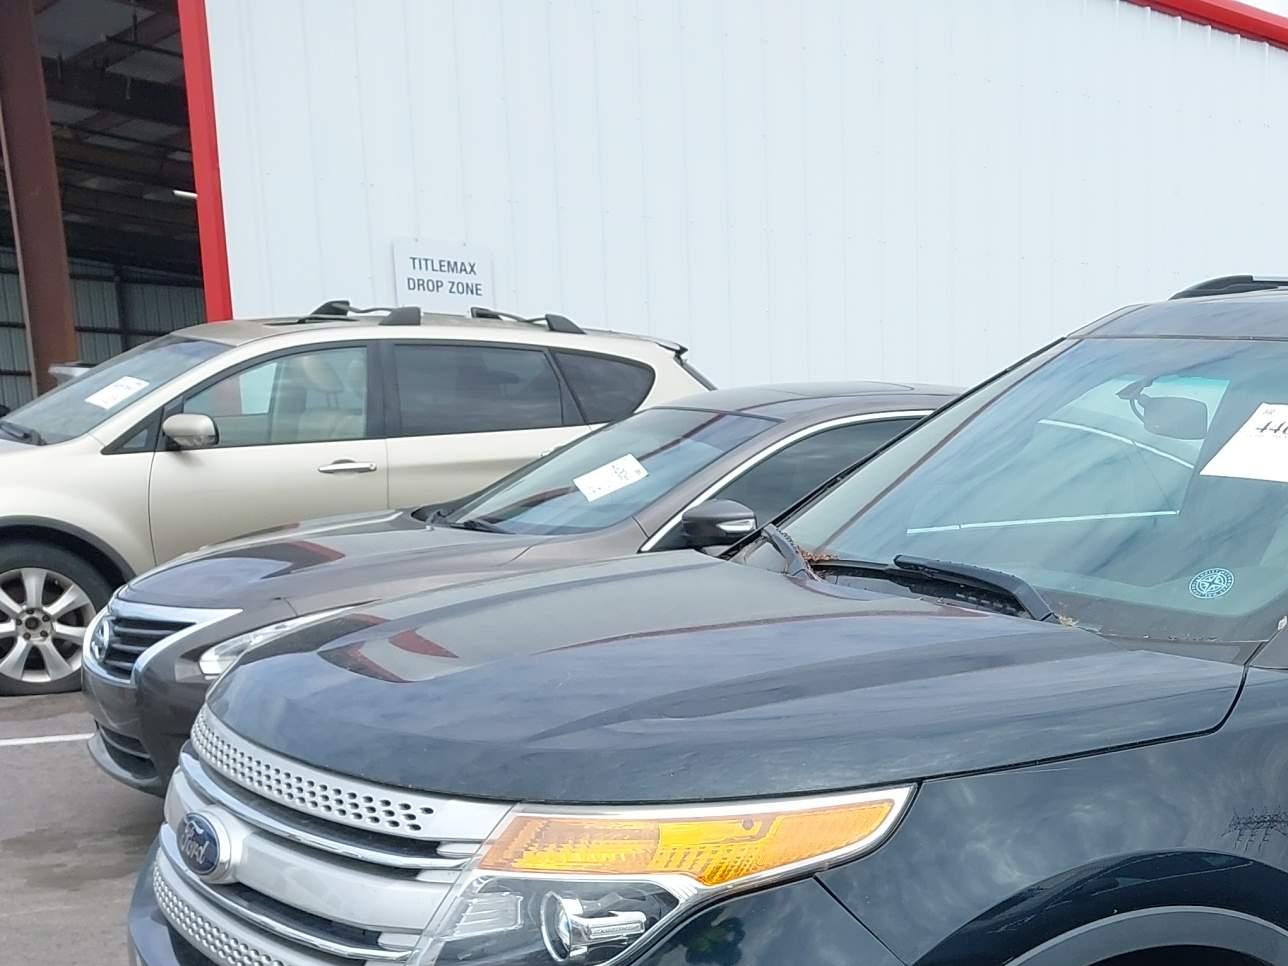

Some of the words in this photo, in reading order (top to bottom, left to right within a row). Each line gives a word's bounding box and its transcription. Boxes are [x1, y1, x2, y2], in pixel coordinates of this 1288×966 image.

[409, 256, 477, 275] TITLEMAX
[407, 277, 444, 293] DROP
[447, 280, 483, 297] ZONE
